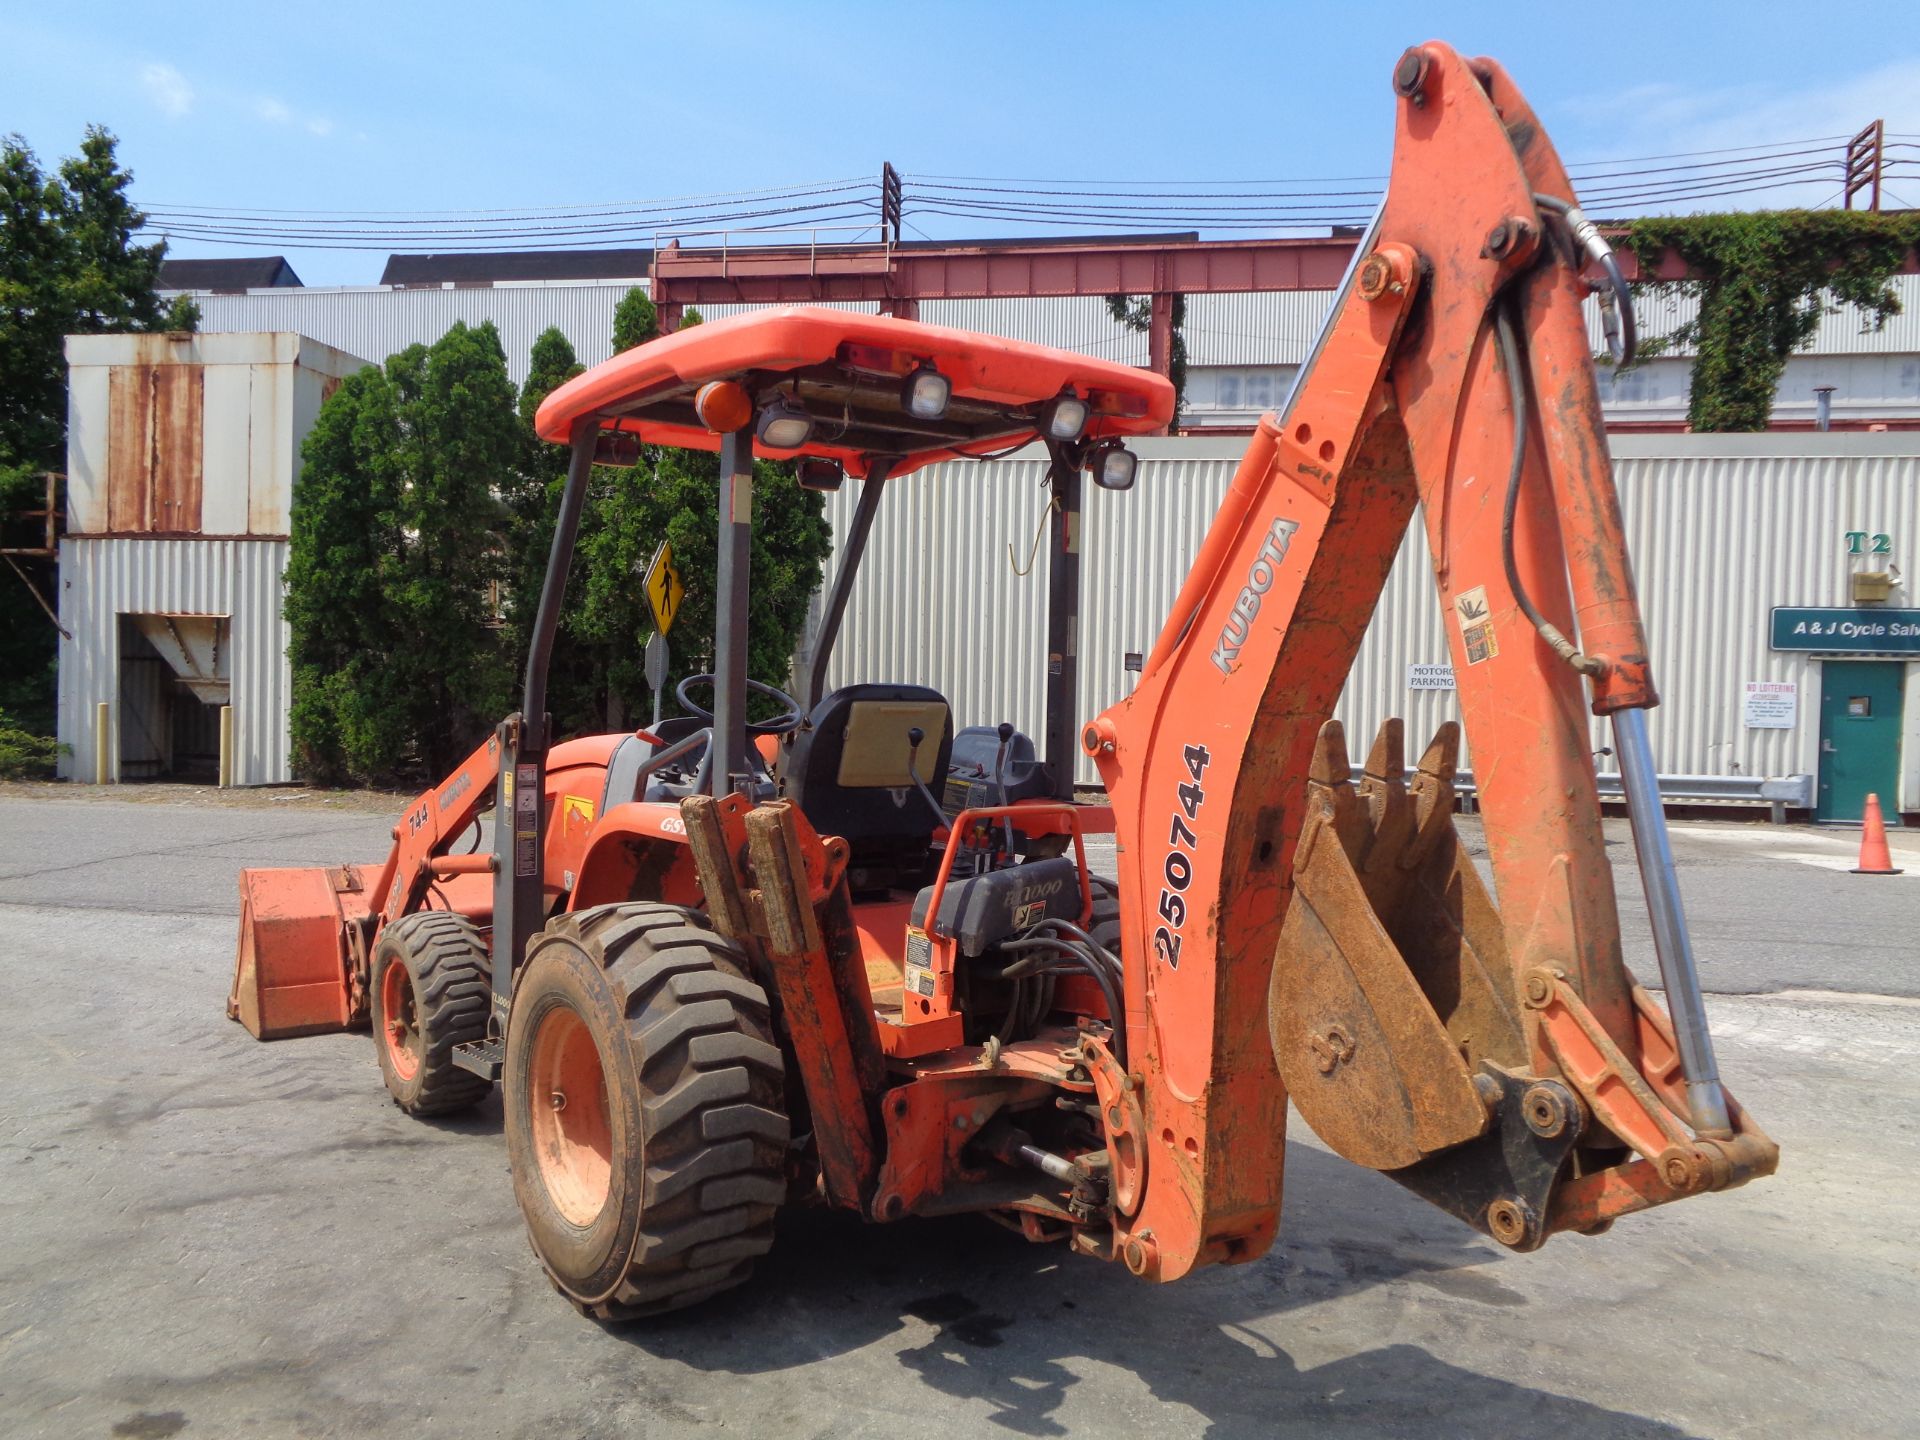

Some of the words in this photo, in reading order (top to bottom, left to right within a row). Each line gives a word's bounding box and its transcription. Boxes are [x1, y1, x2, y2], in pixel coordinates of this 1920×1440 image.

[1211, 517, 1300, 675] KUBOTA
[1793, 621, 1807, 635] A
[1810, 621, 1823, 635] &
[1826, 621, 1837, 636] J
[1840, 622, 1886, 638] Cycle
[1411, 677, 1454, 687] PARKING
[1759, 684, 1796, 693] LOITERING
[409, 802, 429, 837] 744
[1154, 743, 1211, 971] 250744
